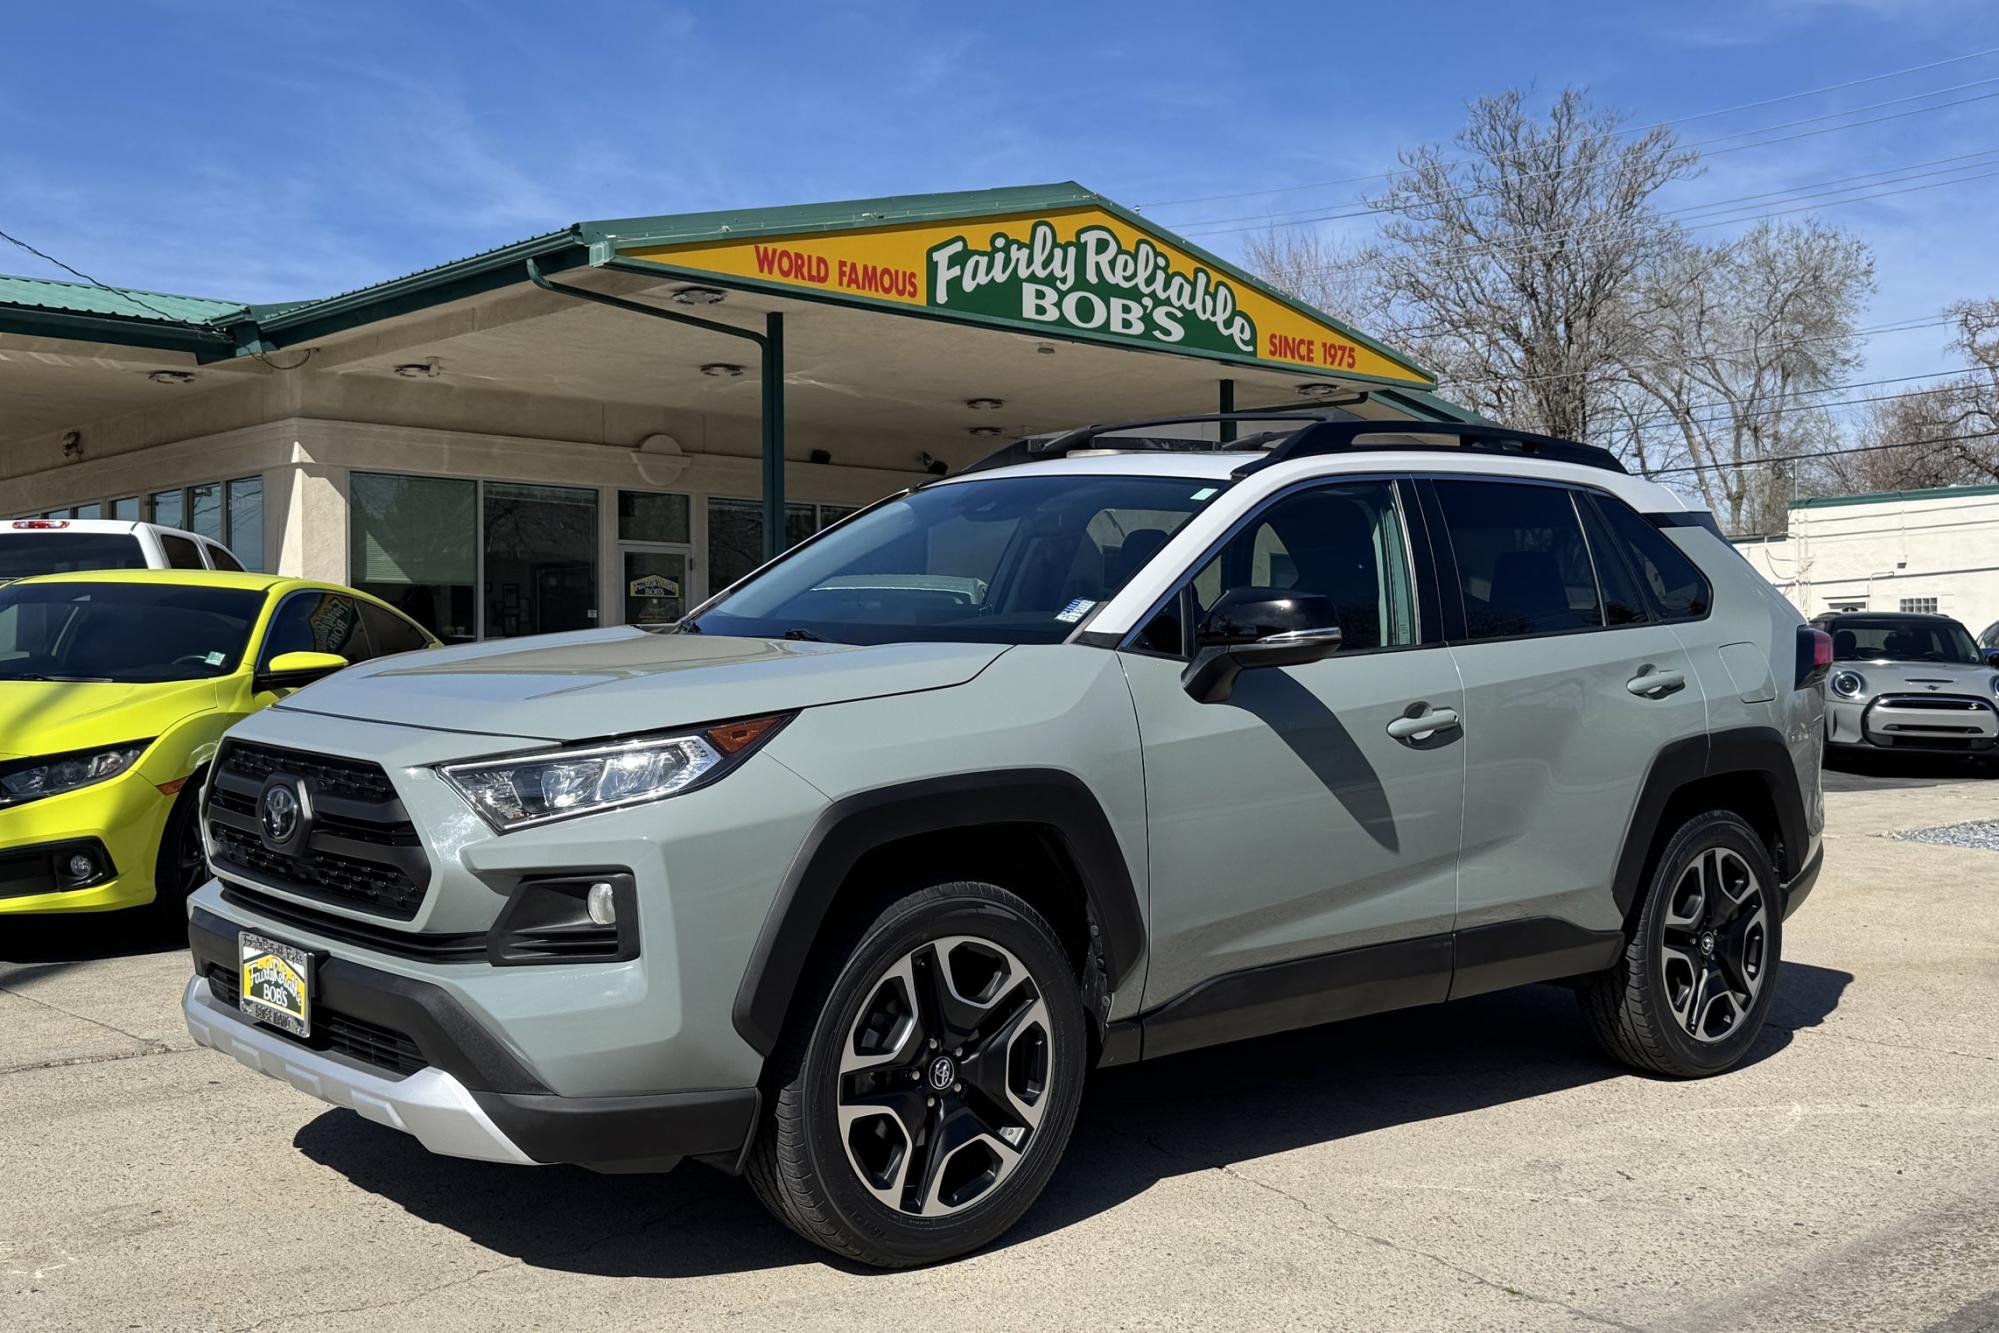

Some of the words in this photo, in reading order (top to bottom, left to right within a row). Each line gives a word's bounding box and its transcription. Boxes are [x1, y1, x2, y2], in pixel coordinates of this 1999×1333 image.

[754, 245, 830, 284] WORLD
[838, 259, 918, 298] FAMOUS
[932, 225, 1076, 304] Fairly
[1080, 230, 1254, 352] Reliable
[1022, 282, 1186, 343] BOB'S
[1269, 333, 1314, 362] SINCE
[1321, 342, 1356, 369] 1975
[263, 983, 288, 1007] BOB'S
